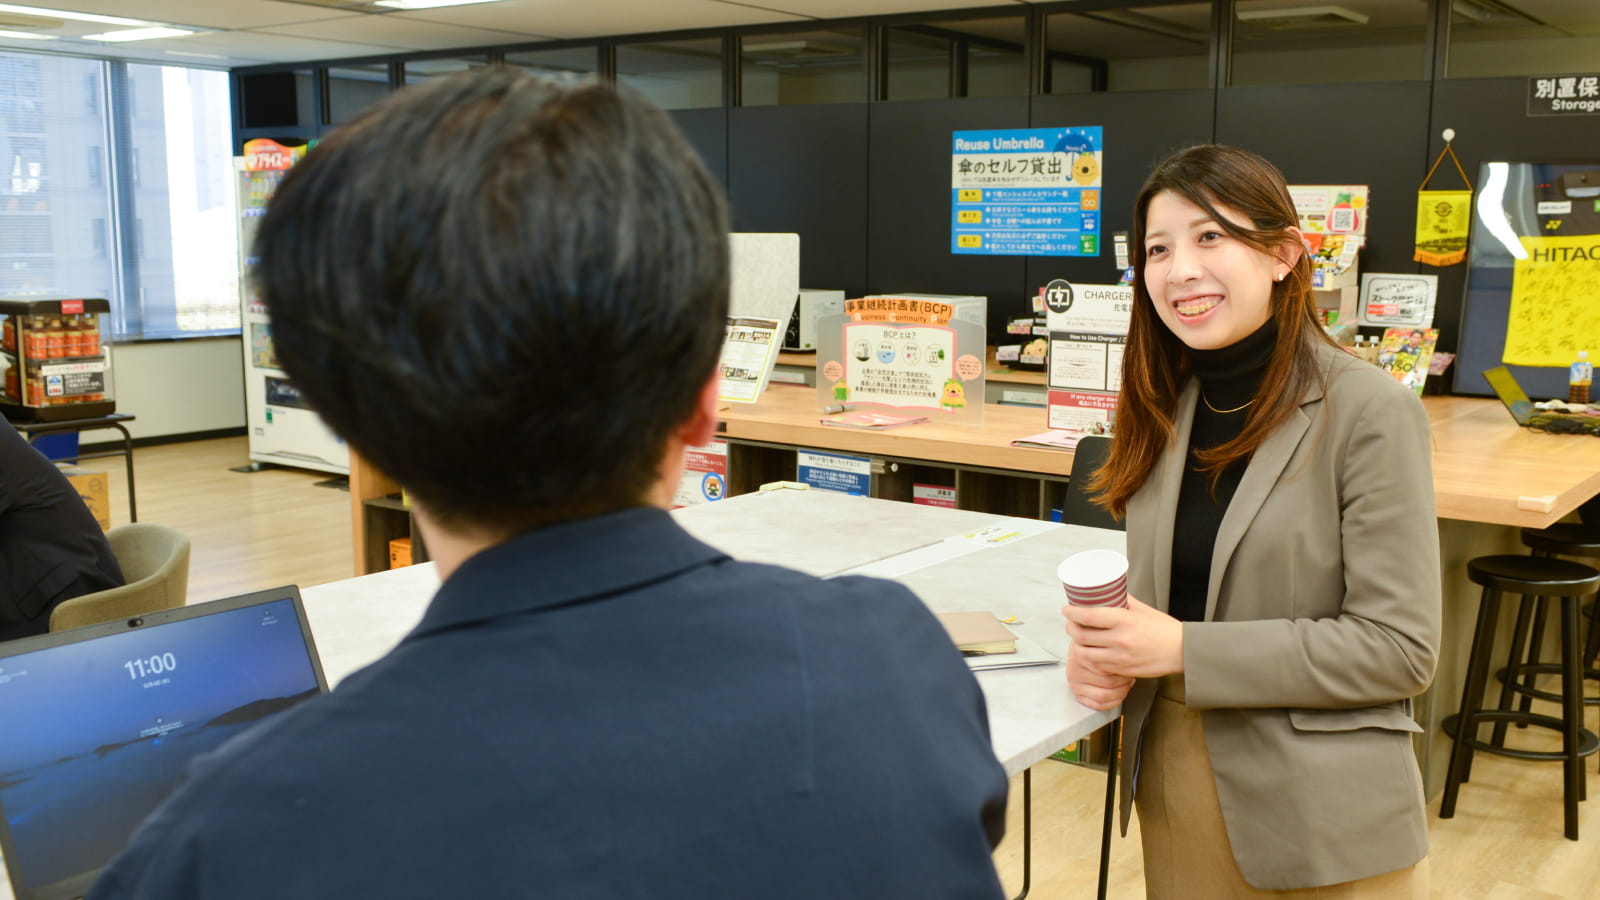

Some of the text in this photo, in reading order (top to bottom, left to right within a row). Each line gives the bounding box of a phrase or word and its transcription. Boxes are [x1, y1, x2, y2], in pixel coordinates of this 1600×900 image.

[1535, 77, 1600, 98] 別置保
[955, 137, 1044, 151] Reuse Umbrella
[958, 157, 1061, 175] 傘のセルフ貸出
[1533, 245, 1600, 262] HITAC
[1084, 290, 1132, 300] CHARGER
[846, 299, 952, 315] 事業継続計画書(BCP)
[1113, 303, 1132, 313] 充電
[854, 313, 948, 325] Business Continuity Plan
[1097, 335, 1118, 344] Charger
[124, 652, 176, 680] 11:00
